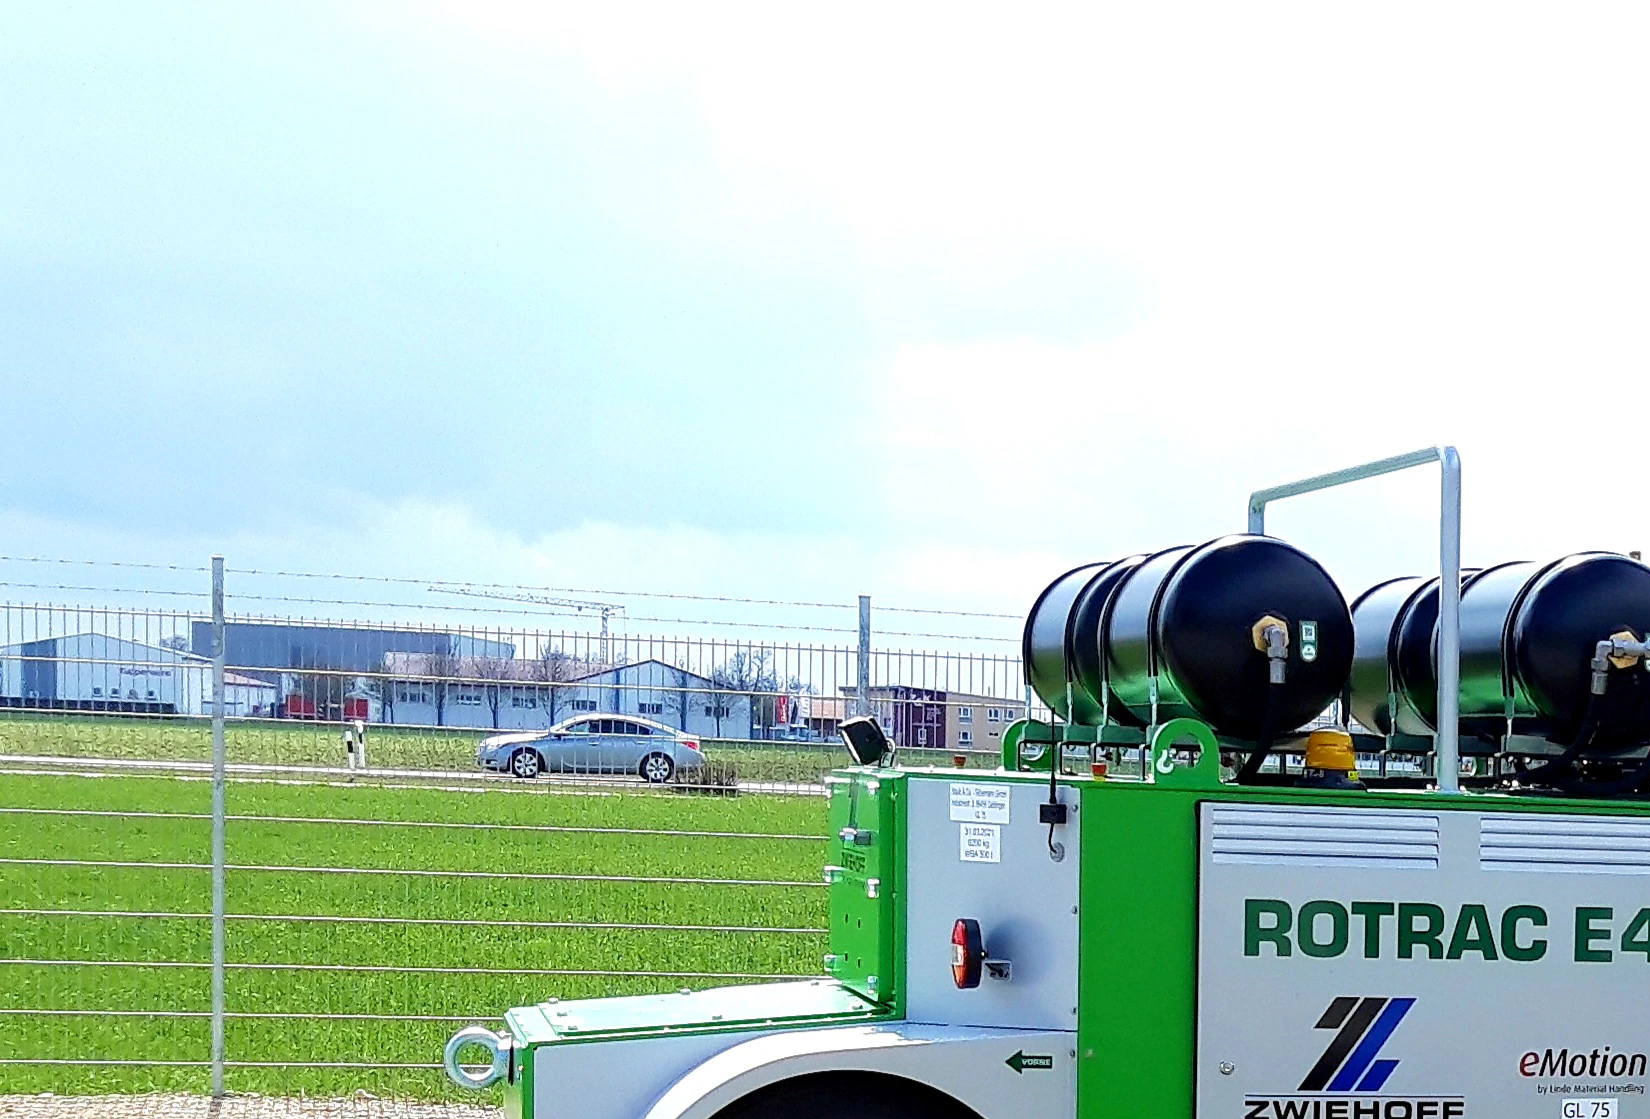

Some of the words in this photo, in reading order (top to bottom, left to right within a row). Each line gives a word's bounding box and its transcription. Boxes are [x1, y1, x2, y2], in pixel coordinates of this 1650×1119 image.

[1244, 898, 1548, 962] ROTRAC
[1519, 1046, 1647, 1077] eMotion
[1537, 1084, 1548, 1096] by
[1573, 1084, 1607, 1094] Material
[1563, 1102, 1585, 1118] GL
[1591, 1102, 1610, 1118] 75
